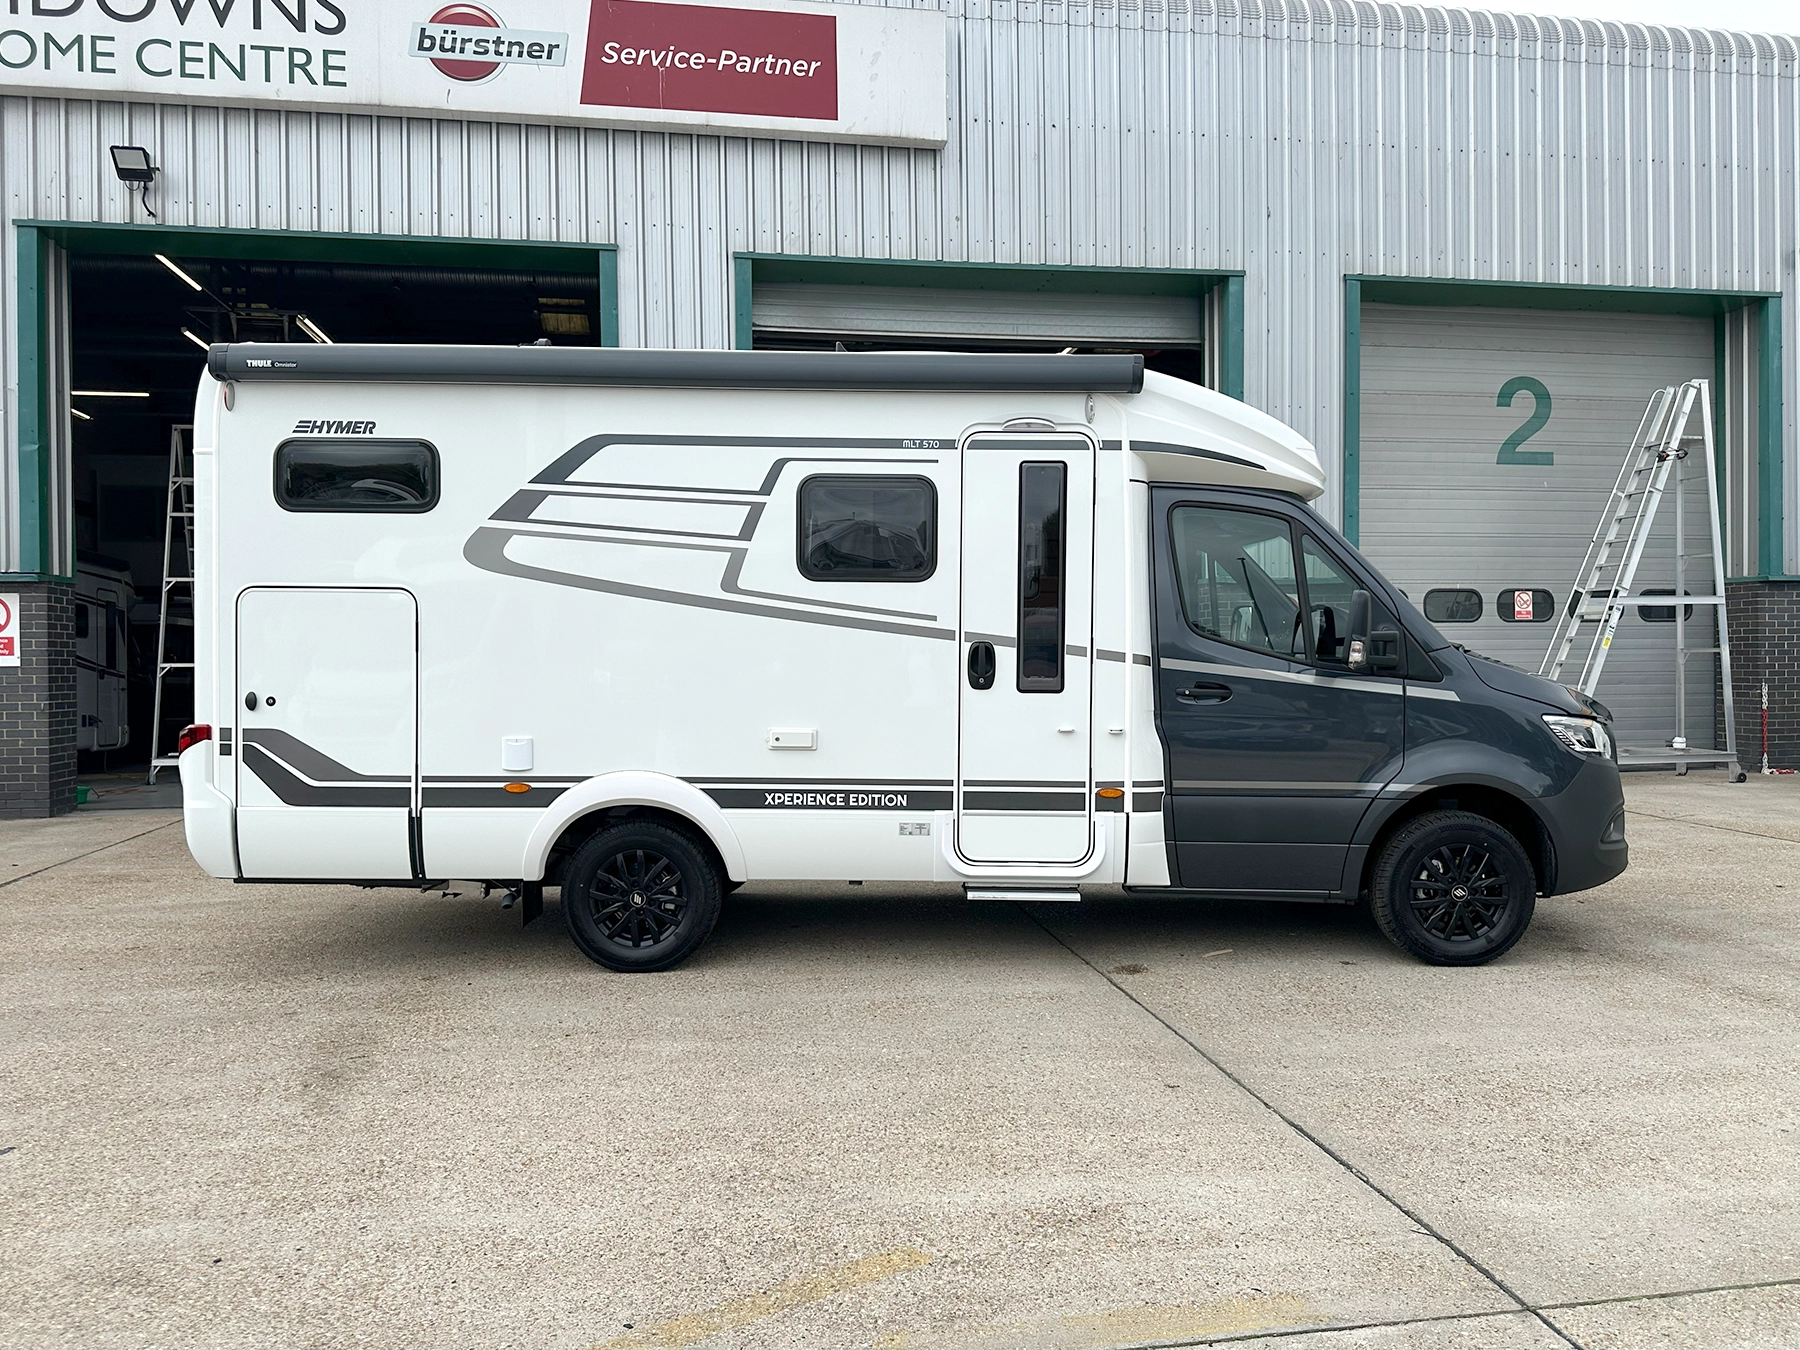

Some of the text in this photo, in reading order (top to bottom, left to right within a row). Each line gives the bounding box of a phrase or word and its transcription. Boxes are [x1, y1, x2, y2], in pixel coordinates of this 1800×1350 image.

[417, 27, 560, 60] bürstner
[136, 38, 347, 87] CENTRE
[600, 41, 822, 77] Service-Partner
[246, 359, 272, 368] THULE
[308, 420, 377, 434] HYMER
[1496, 376, 1554, 466] 2
[902, 439, 940, 449] MLT 570
[764, 792, 908, 807] XPERIENCE EDITION
